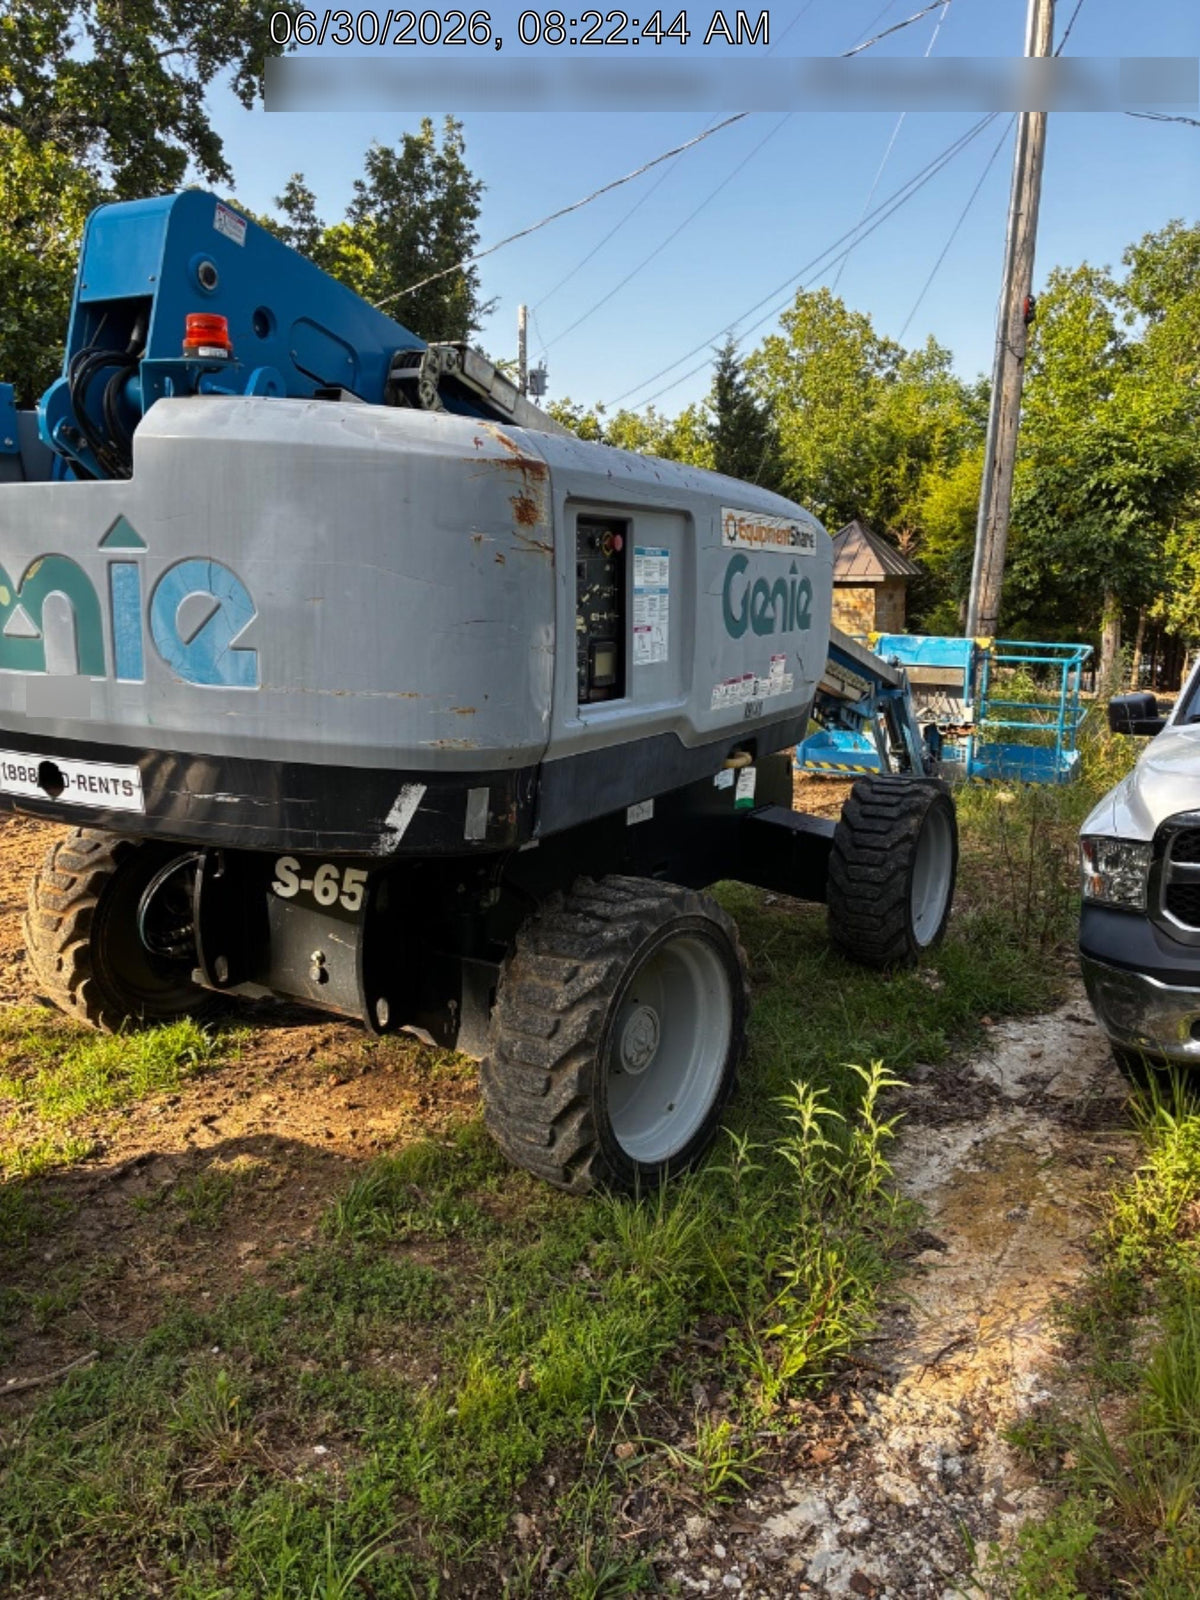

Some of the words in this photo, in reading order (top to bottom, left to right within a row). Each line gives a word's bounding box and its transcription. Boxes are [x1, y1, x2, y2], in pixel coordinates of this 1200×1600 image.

[738, 516, 815, 548] EquipmentShare
[722, 553, 813, 639] Genie
[271, 856, 369, 911] S-65
